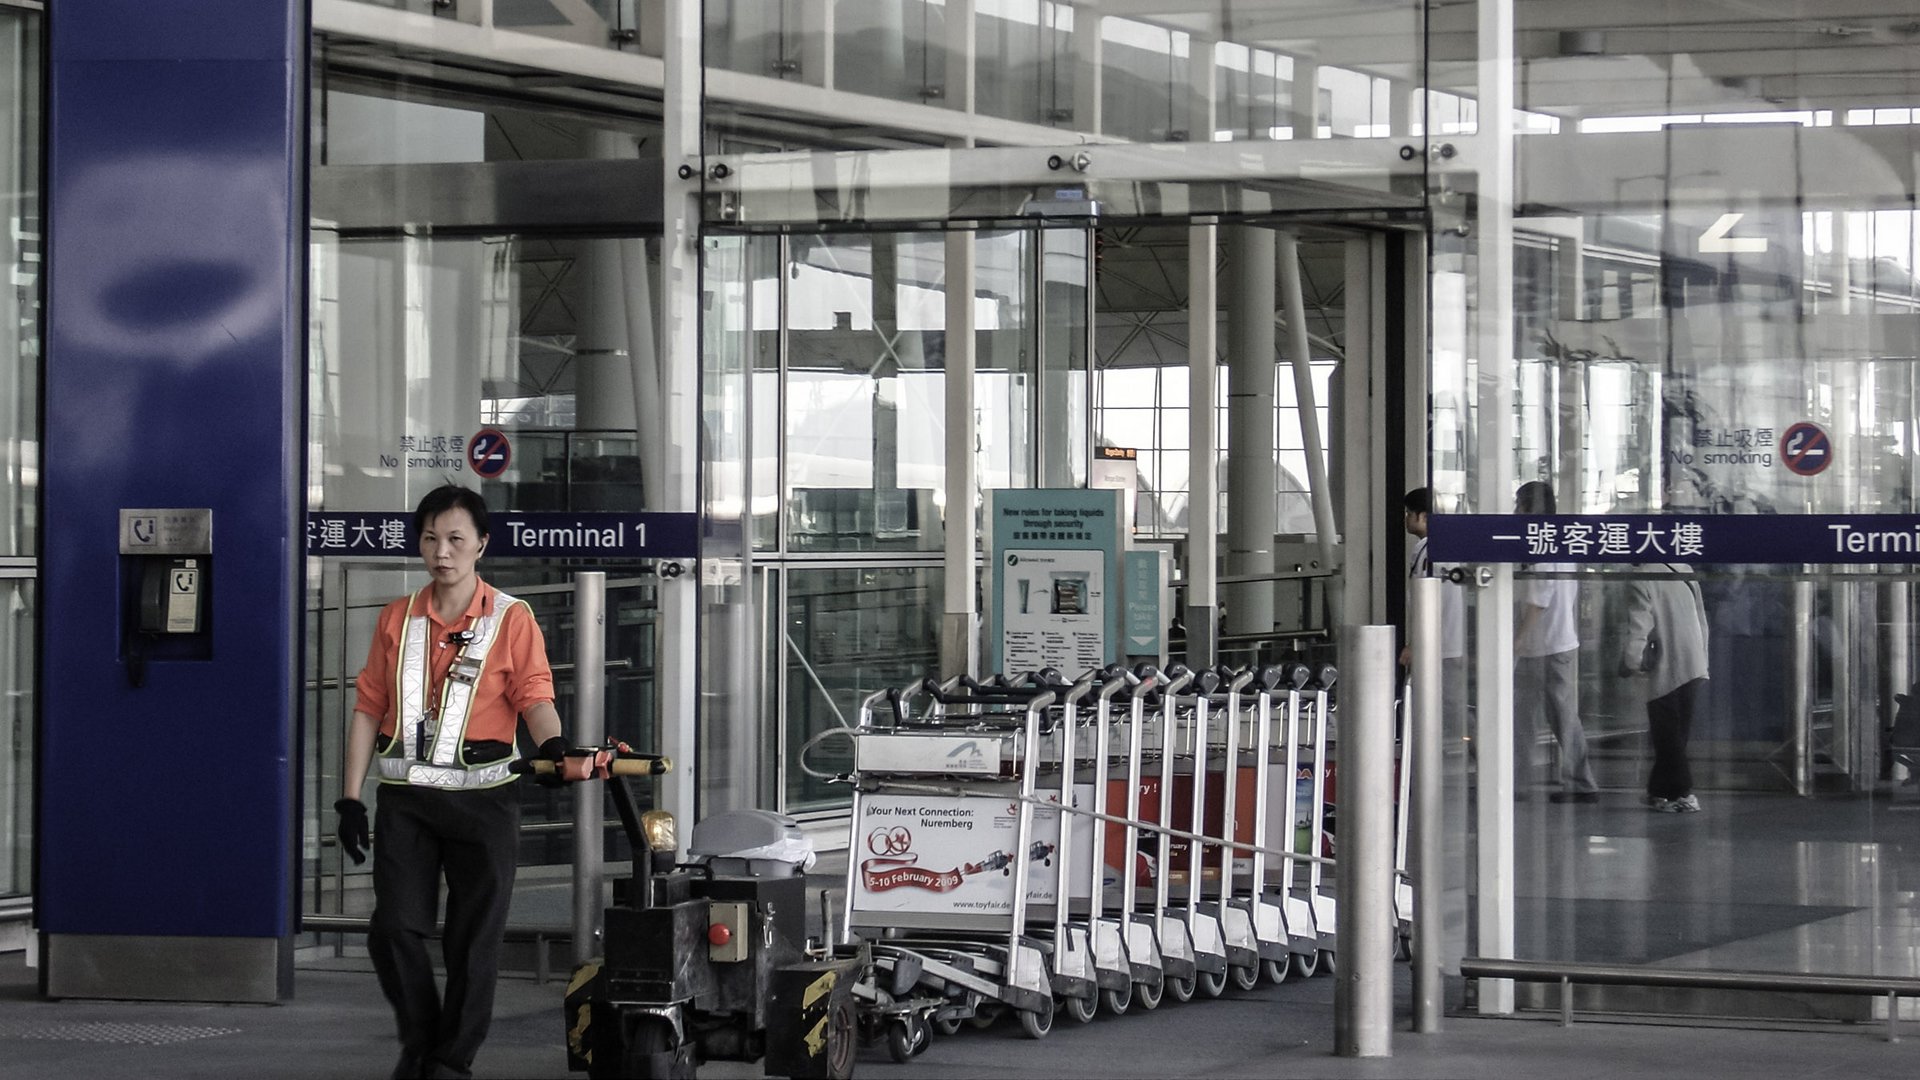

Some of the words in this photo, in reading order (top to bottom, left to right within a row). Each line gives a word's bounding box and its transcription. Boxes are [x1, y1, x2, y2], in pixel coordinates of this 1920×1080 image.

[380, 454, 398, 468] No
[407, 454, 463, 471] smoking
[1671, 450, 1694, 465] No
[1703, 451, 1772, 468] smoking
[1003, 508, 1019, 516] New
[1021, 508, 1039, 516] rules
[1042, 508, 1052, 516] for
[1054, 508, 1077, 518] taking
[1079, 508, 1104, 518] liquids
[1023, 520, 1052, 529] through
[1053, 520, 1084, 529] security
[507, 522, 624, 547] Terminal
[635, 523, 647, 547] 1
[1492, 522, 1704, 556] 一號客運大樓
[871, 806, 891, 817] Your
[895, 807, 916, 816] Next
[919, 807, 974, 818] Connection:
[920, 819, 973, 830] Nuremberg
[869, 877, 890, 887] 5-10
[892, 872, 934, 885] February
[935, 876, 959, 887] 2009
[953, 899, 1011, 910] www.toyfair.de
